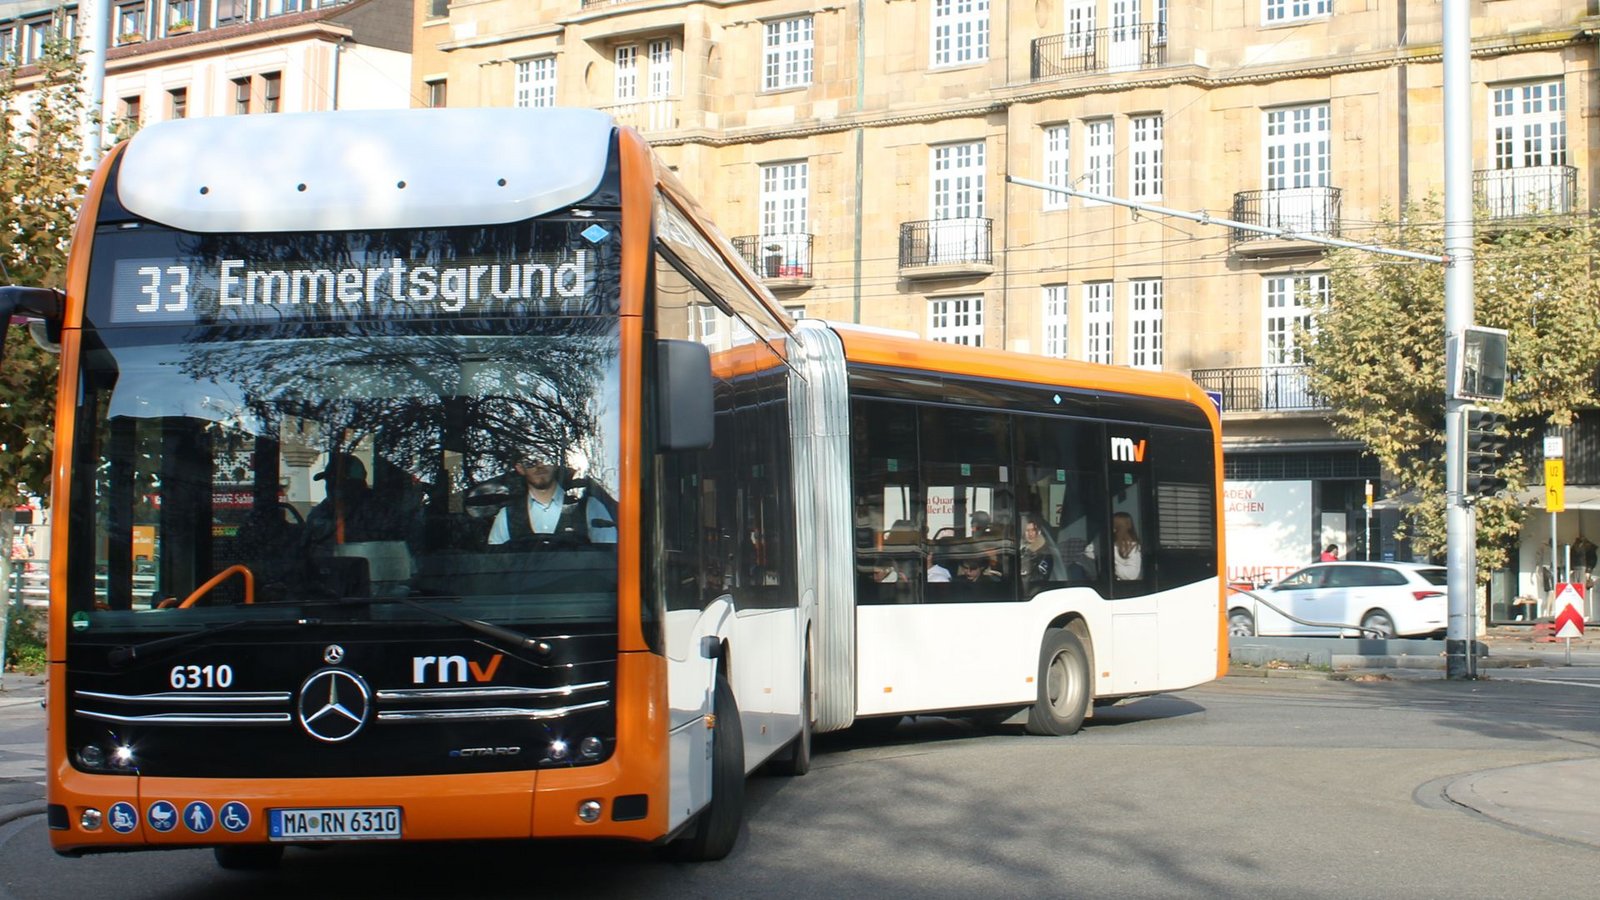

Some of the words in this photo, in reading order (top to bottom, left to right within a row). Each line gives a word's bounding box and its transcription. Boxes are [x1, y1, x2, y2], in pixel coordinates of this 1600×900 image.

[136, 265, 190, 312] 33
[219, 248, 586, 312] Emmertsgrund
[1223, 489, 1252, 500] ADEN
[170, 665, 233, 688] 6310
[412, 654, 503, 683] rnv
[284, 813, 309, 833] MA
[321, 812, 345, 832] RN
[351, 811, 396, 832] 6310
